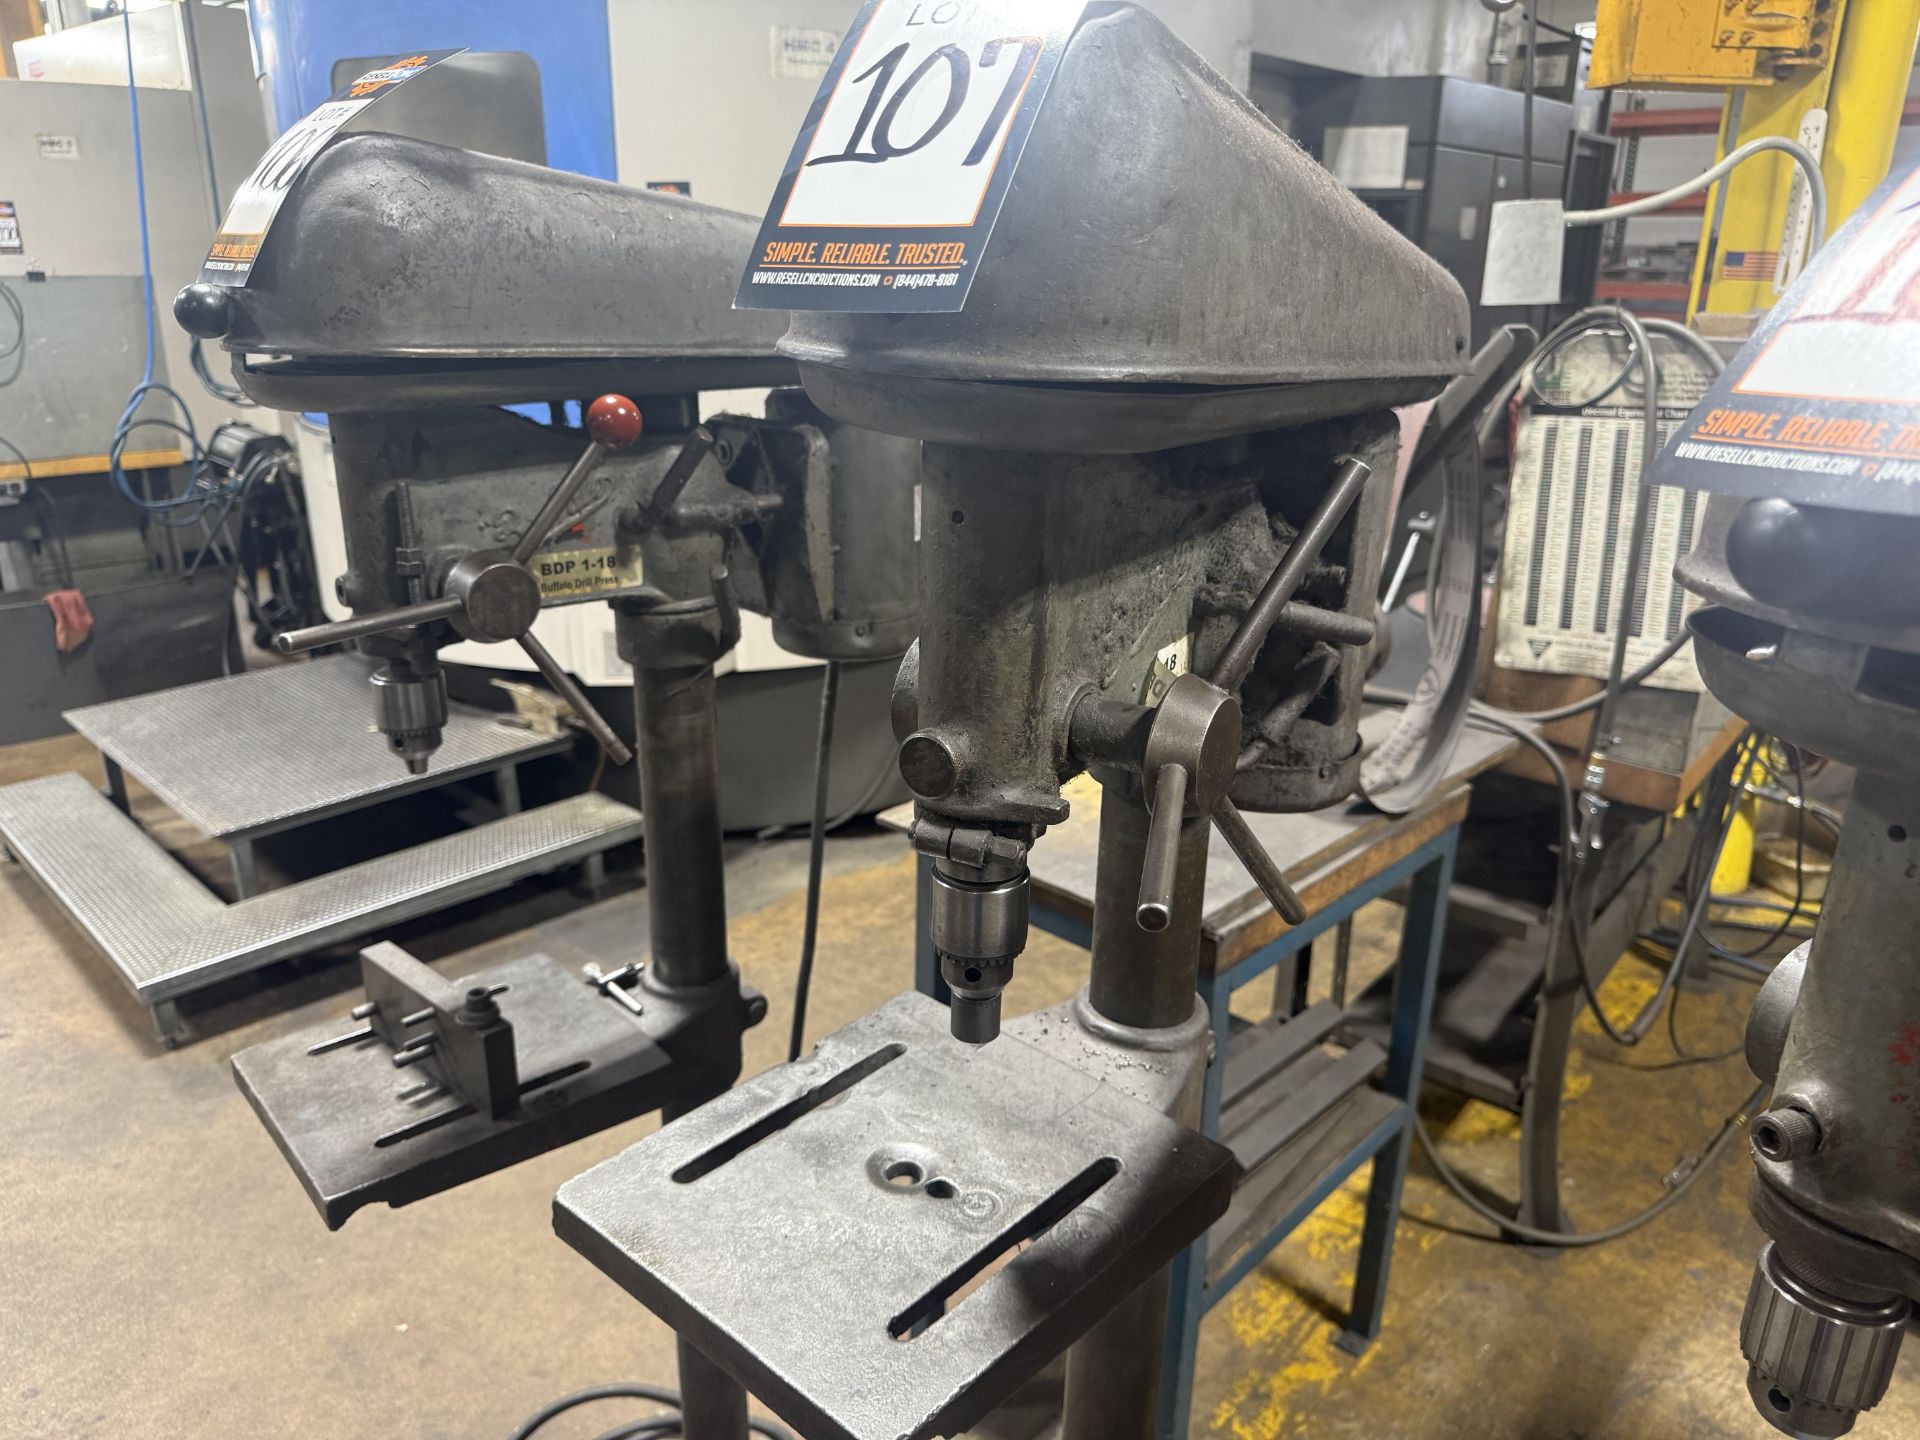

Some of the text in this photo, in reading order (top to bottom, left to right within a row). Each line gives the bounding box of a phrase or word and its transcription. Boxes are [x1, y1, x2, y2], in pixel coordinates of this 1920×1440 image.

[804, 36, 1043, 167] 107
[763, 241, 818, 263] SIMPLE.
[820, 242, 892, 264] RELIABLE.
[752, 271, 960, 290] WWW.RESELLCNCAUCTIONS.COM (844)478-8181
[541, 556, 617, 576] BDP 1-18
